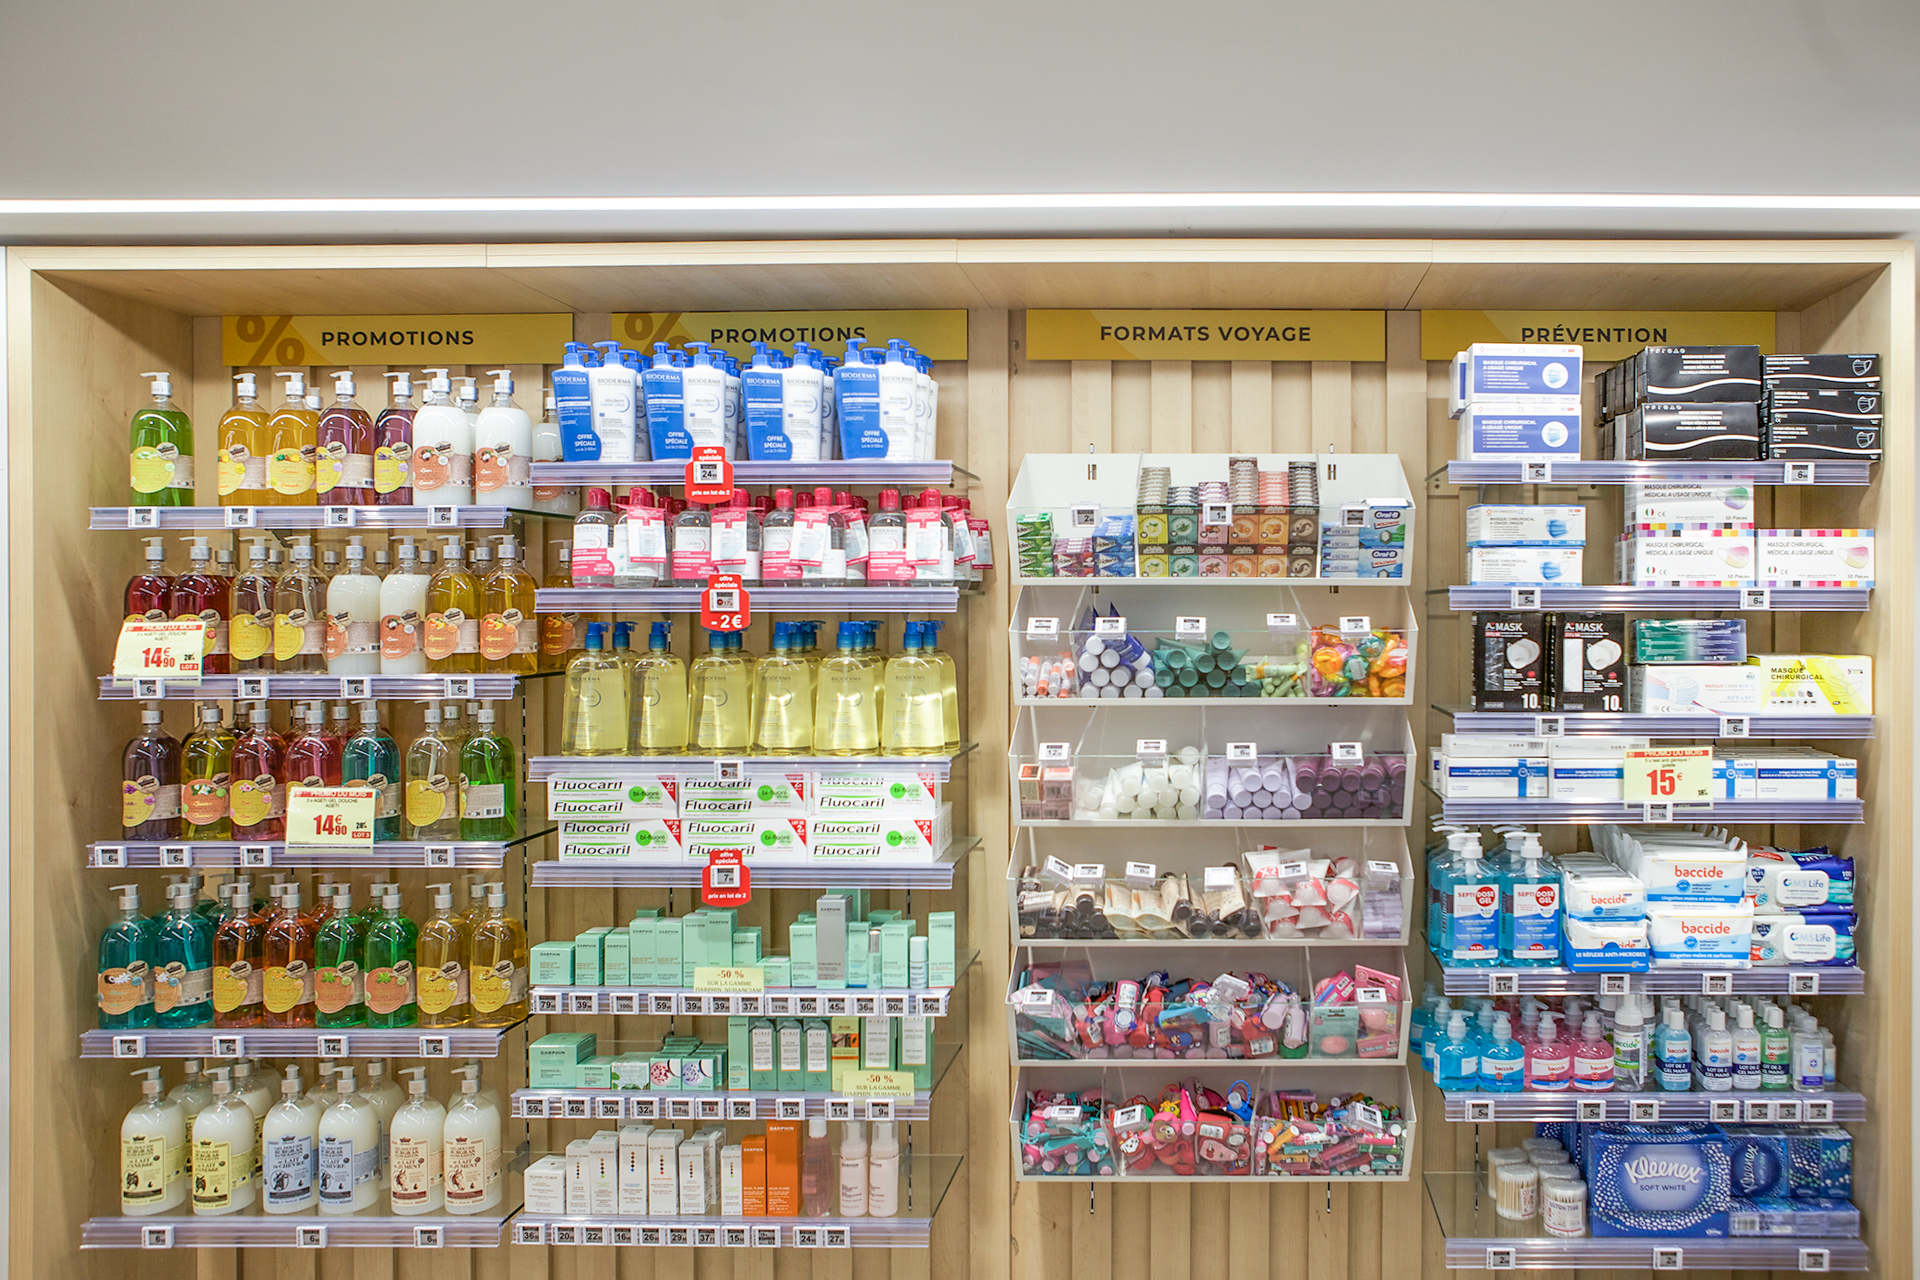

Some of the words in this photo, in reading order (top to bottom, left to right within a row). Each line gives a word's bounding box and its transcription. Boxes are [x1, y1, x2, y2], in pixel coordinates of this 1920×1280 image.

[711, 327, 866, 344] PROMOTIONS
[1100, 326, 1210, 341] FORMATS
[1218, 326, 1311, 342] VOYAGE
[1521, 324, 1667, 342] PRÉVENTION
[321, 330, 474, 347] PROMOTIONS
[554, 376, 588, 384] BIODERMA
[646, 373, 680, 382] BIODERMA
[840, 372, 876, 381] BIODERMA
[746, 378, 781, 386] BIODERMA
[864, 430, 880, 438] OFFRE
[574, 440, 596, 448] SPÉCIALE
[665, 438, 688, 446] SPÉCIALE
[861, 436, 883, 444] SPÉCIALE
[720, 615, 742, 628] 2€
[1495, 622, 1523, 632] MASK
[1575, 623, 1604, 632] MASK
[553, 781, 623, 790] Fluocaril
[553, 801, 623, 812] Fluocaril
[684, 800, 752, 811] Fluocaril
[819, 797, 885, 807] Fluocaril
[563, 822, 630, 833] Fluocaril
[688, 822, 756, 833] Fluocaril
[813, 823, 880, 833] Fluocaril
[564, 844, 631, 855] Fluocaril
[813, 845, 881, 856] Fluocaril
[1674, 865, 1723, 878] baccide
[1808, 879, 1824, 888] Life
[1591, 895, 1627, 904] baccide
[1682, 921, 1730, 934] baccide
[1815, 933, 1831, 942] Life
[718, 970, 731, 978] -50
[734, 970, 745, 978] %
[866, 1075, 882, 1083] -50
[885, 1075, 894, 1083] %
[1624, 1156, 1700, 1184] Kleenex
